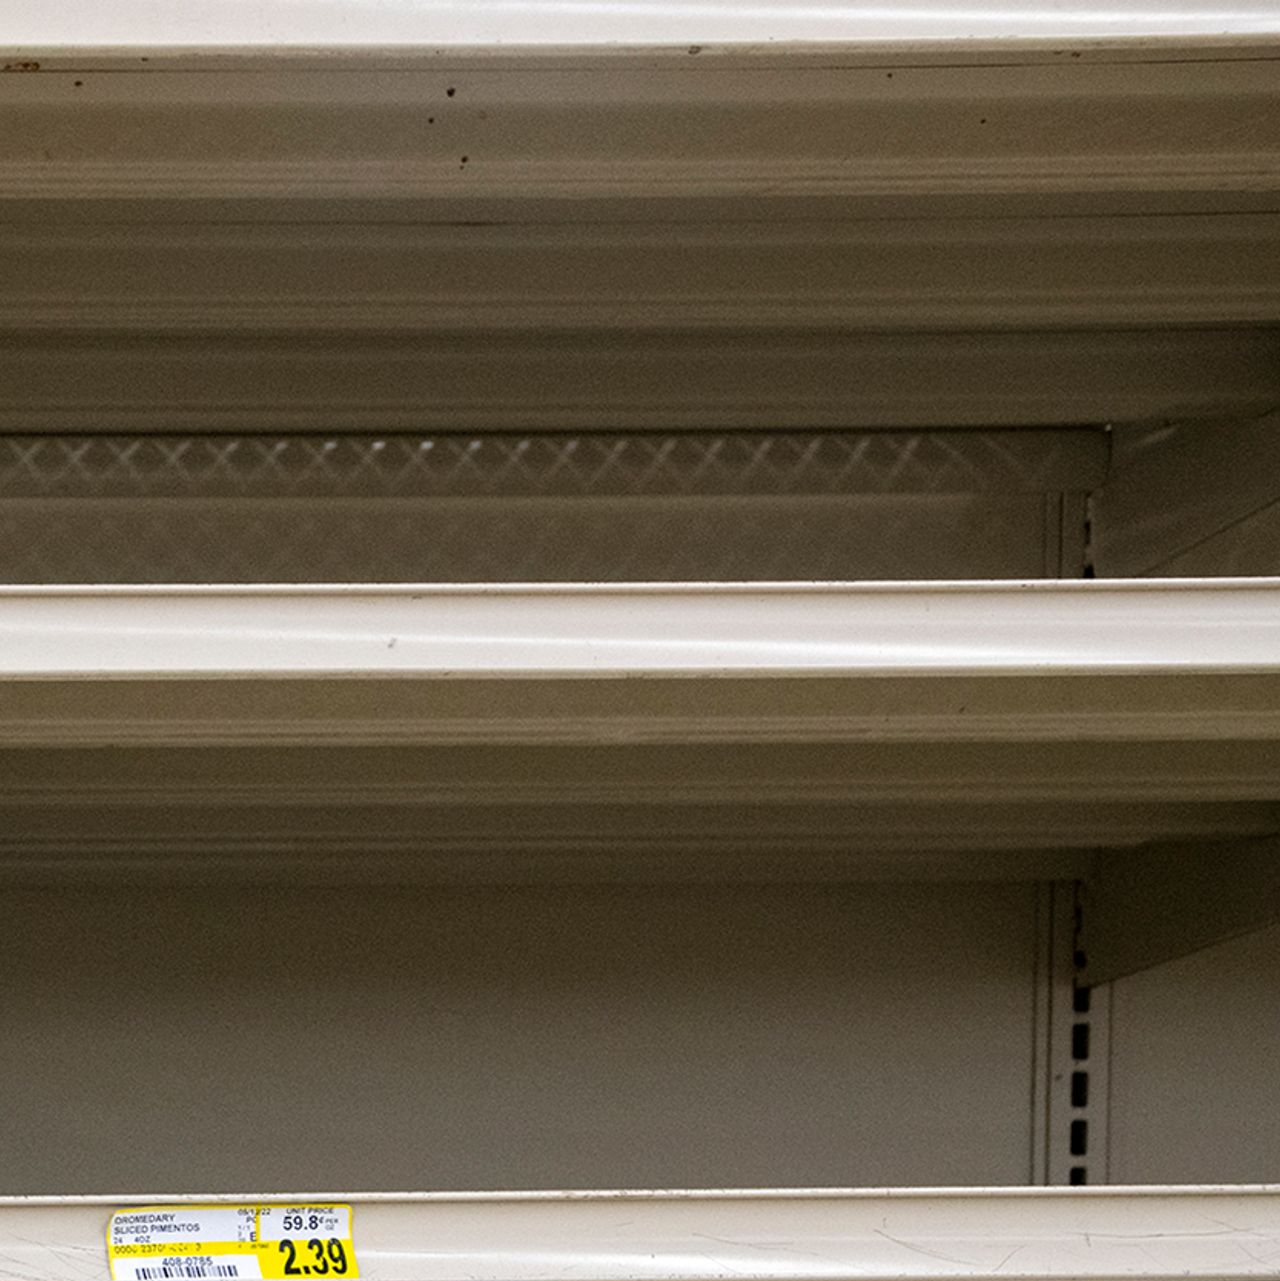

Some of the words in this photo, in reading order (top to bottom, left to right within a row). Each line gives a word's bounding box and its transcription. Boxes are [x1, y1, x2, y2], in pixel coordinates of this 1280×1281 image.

[114, 1225, 149, 1235] SLICED
[150, 1223, 200, 1233] PIMENTOS
[279, 1238, 348, 1276] 2.39
